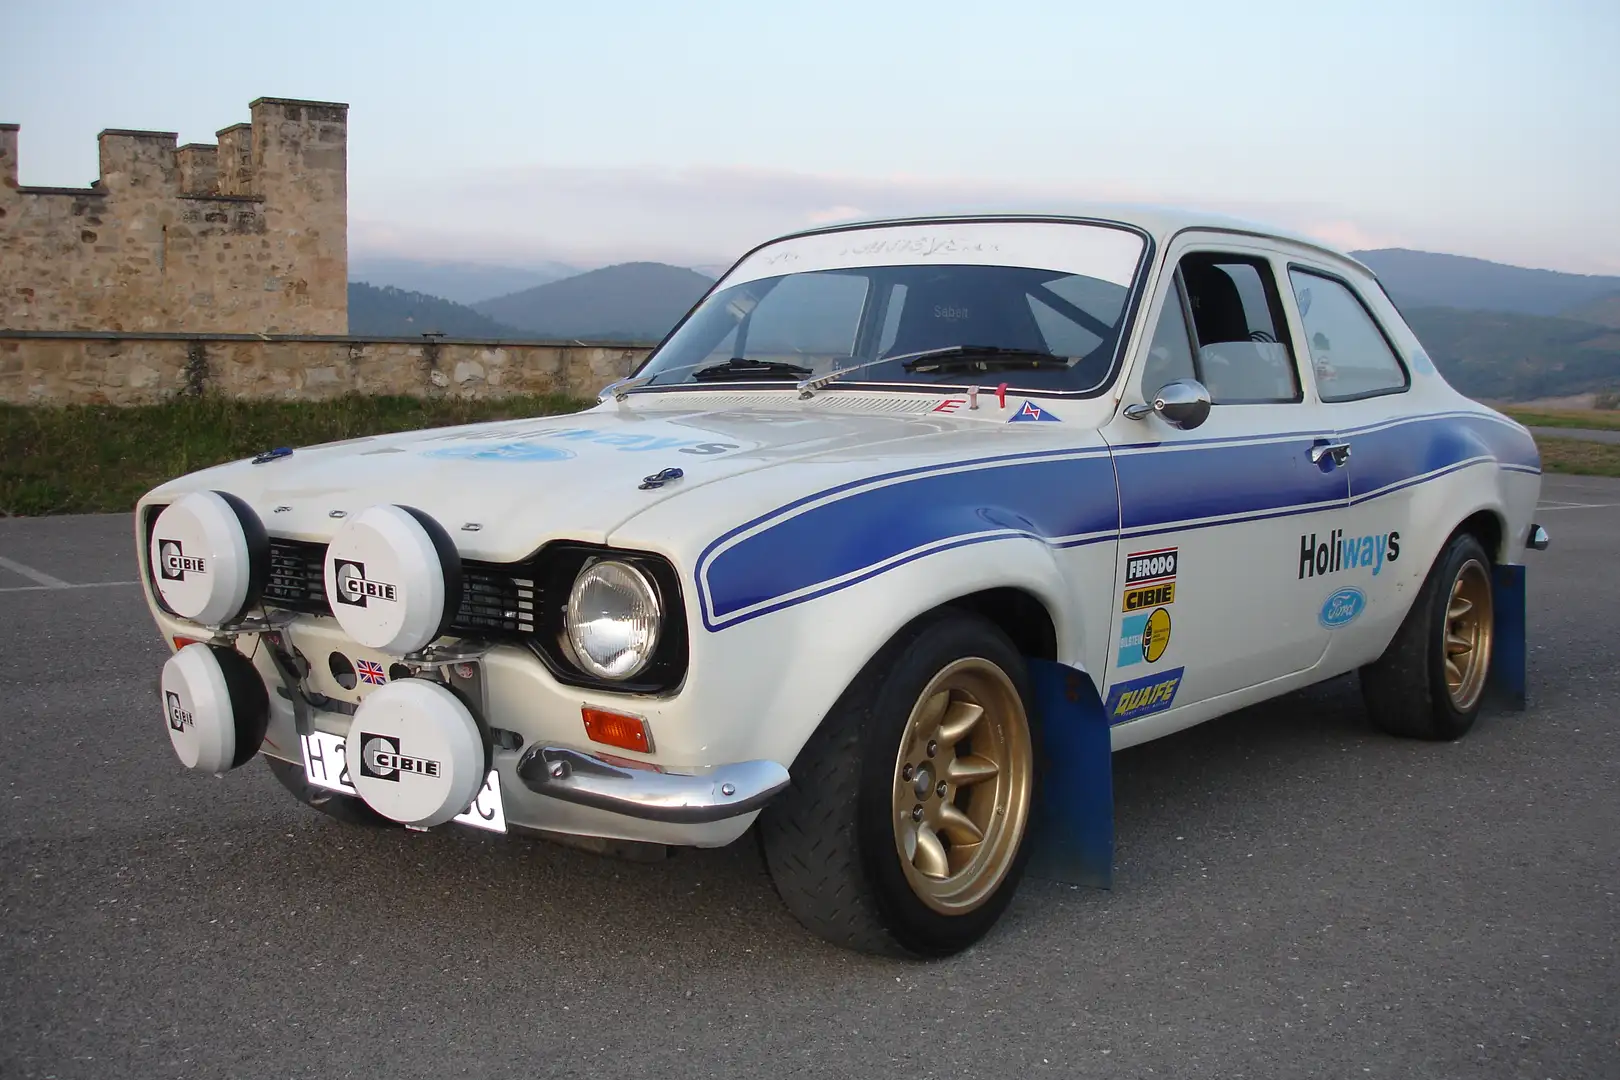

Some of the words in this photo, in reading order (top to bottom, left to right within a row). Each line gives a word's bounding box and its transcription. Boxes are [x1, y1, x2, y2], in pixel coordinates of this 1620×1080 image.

[1128, 555, 1175, 579] FERODO
[1298, 529, 1400, 579] Holiways
[1114, 678, 1181, 715] QUAIFE
